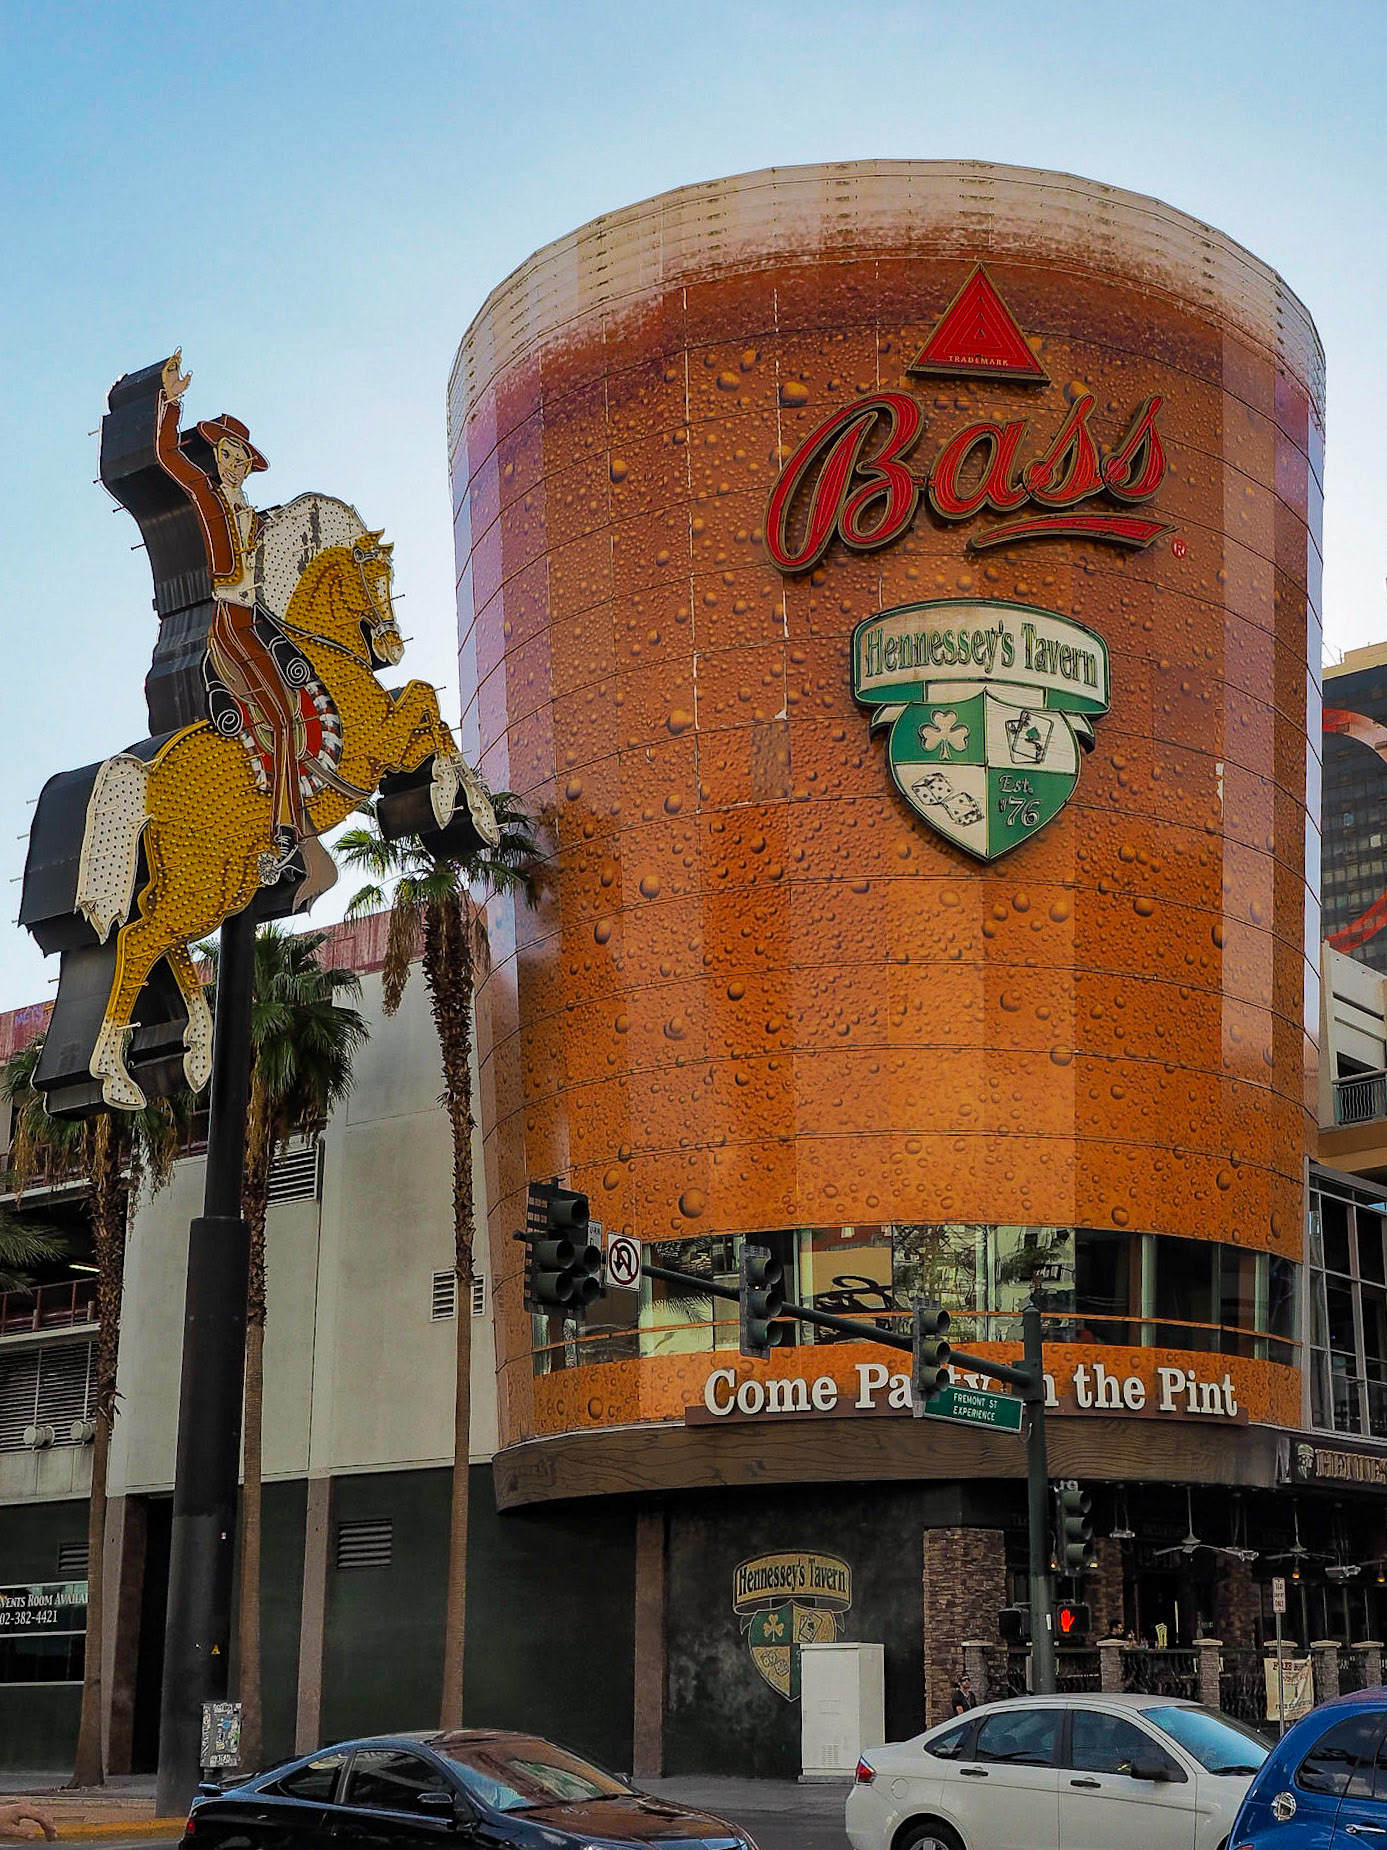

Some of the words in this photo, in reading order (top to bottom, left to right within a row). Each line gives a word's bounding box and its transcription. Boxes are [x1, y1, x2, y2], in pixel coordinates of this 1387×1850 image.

[949, 355, 1009, 367] TRADEMARK
[763, 389, 1168, 573] Bass
[865, 620, 1015, 678] Hennessey's
[1020, 622, 1098, 687] Tavern
[704, 1368, 838, 1416] Come
[1073, 1363, 1146, 1411] the
[1157, 1367, 1239, 1417] Pint
[953, 1392, 986, 1408] FREMONT
[988, 1399, 998, 1409] ST
[952, 1405, 996, 1421] EXPERIENCE
[738, 1558, 805, 1596] Hennessey's
[808, 1557, 847, 1593] Tavern
